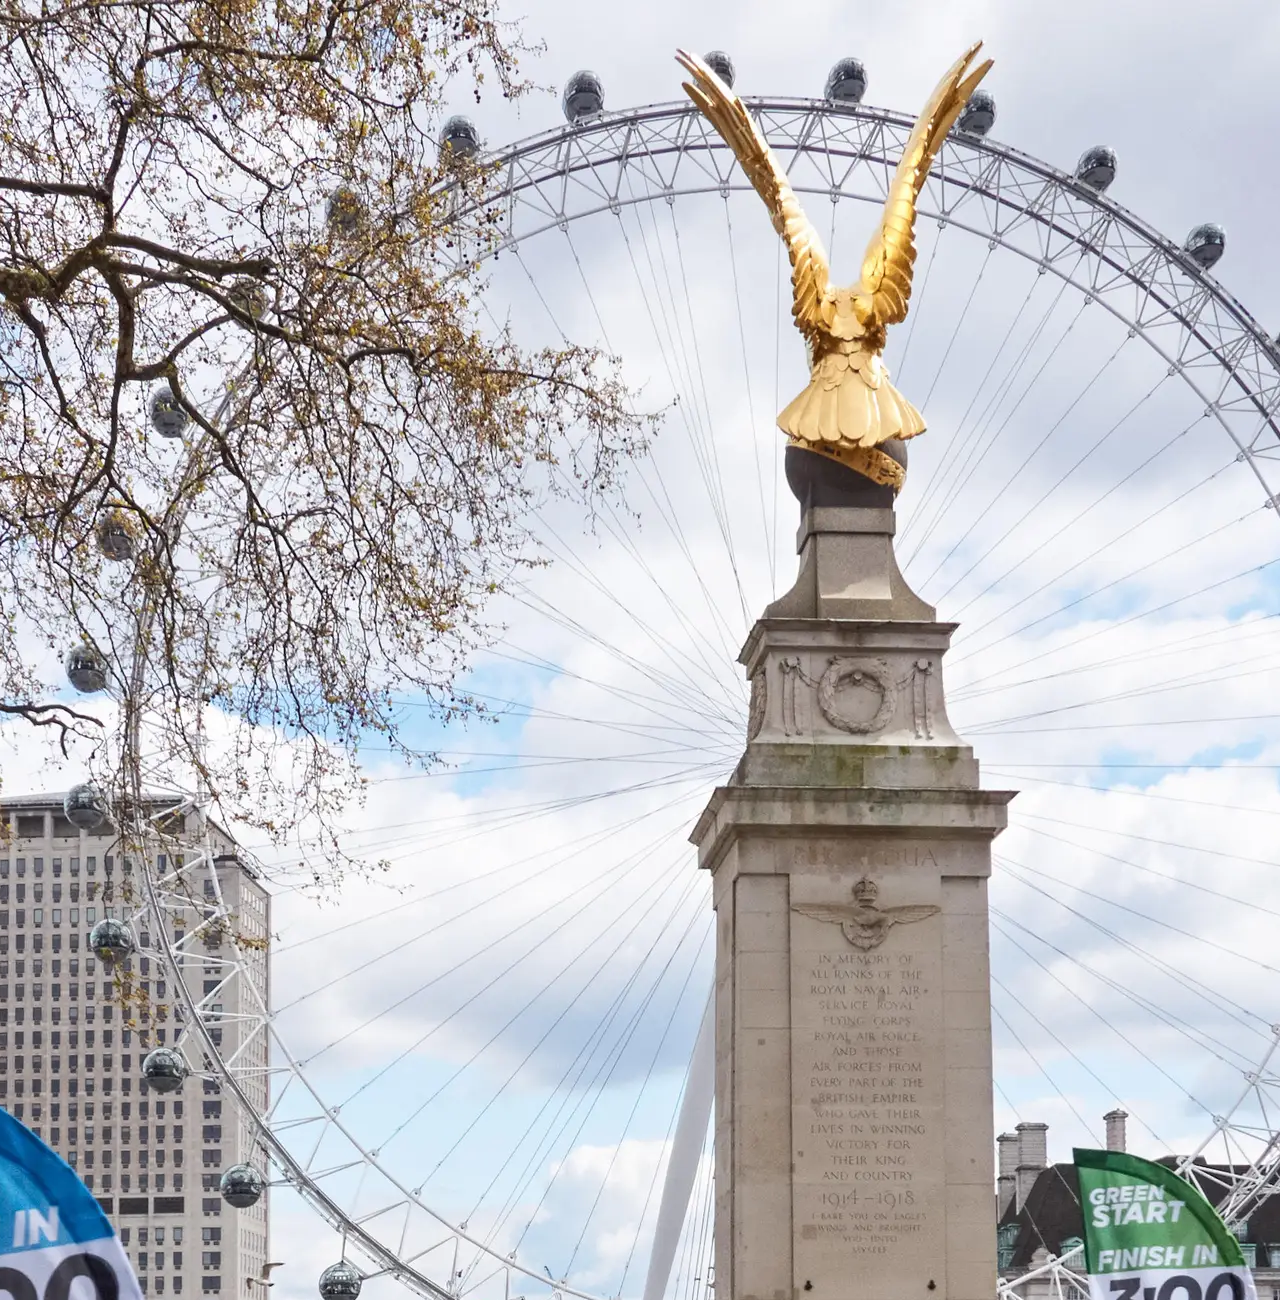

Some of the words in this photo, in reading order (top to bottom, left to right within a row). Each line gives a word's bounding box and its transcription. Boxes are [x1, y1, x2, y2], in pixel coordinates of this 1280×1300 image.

[818, 954, 831, 964] IN
[838, 954, 890, 964] MEMORY
[899, 954, 913, 964] OF
[811, 970, 828, 980] ALL
[834, 970, 873, 980] RANKS
[878, 970, 892, 980] OF
[901, 970, 922, 980] THE
[810, 985, 846, 995] ROYAL
[854, 985, 892, 995] NAVAL
[899, 985, 921, 995] AIR
[818, 1001, 868, 1010] SERVICE
[877, 1001, 915, 1010] ROYAL
[823, 1016, 864, 1026] FLYING
[873, 1016, 911, 1026] CORPS
[814, 1032, 850, 1041] ROYAL
[856, 1032, 875, 1041] AIR
[882, 1032, 919, 1041] FORCE
[832, 1047, 857, 1056] AND
[864, 1047, 902, 1056] THOSE
[812, 1062, 831, 1072] AIR
[837, 1062, 881, 1072] FORCES
[888, 1062, 922, 1072] FROM
[810, 1078, 842, 1088] EVERY
[849, 1078, 876, 1088] PART
[881, 1078, 896, 1088] OF
[903, 1078, 925, 1088] THE
[819, 1094, 864, 1103] BRITISH
[873, 1094, 917, 1103] EMPIRE
[814, 1109, 843, 1118] WHO
[848, 1109, 878, 1118] GAVE
[887, 1109, 920, 1118] THEIR
[810, 1124, 843, 1134] LIVES
[850, 1124, 863, 1134] IN
[870, 1124, 926, 1134] WINNING
[825, 1140, 878, 1150] VICTORY
[887, 1140, 911, 1150] FOR
[830, 1155, 867, 1165] THEIR
[875, 1155, 906, 1165] KING
[822, 1171, 848, 1180] AND
[854, 1171, 913, 1180] COUNTRY
[1089, 1185, 1164, 1206] GREEN
[1091, 1200, 1185, 1228] START
[14, 1206, 59, 1247] IN
[853, 1224, 872, 1232] AND
[1098, 1246, 1187, 1272] FINISH
[1192, 1245, 1217, 1265] IN
